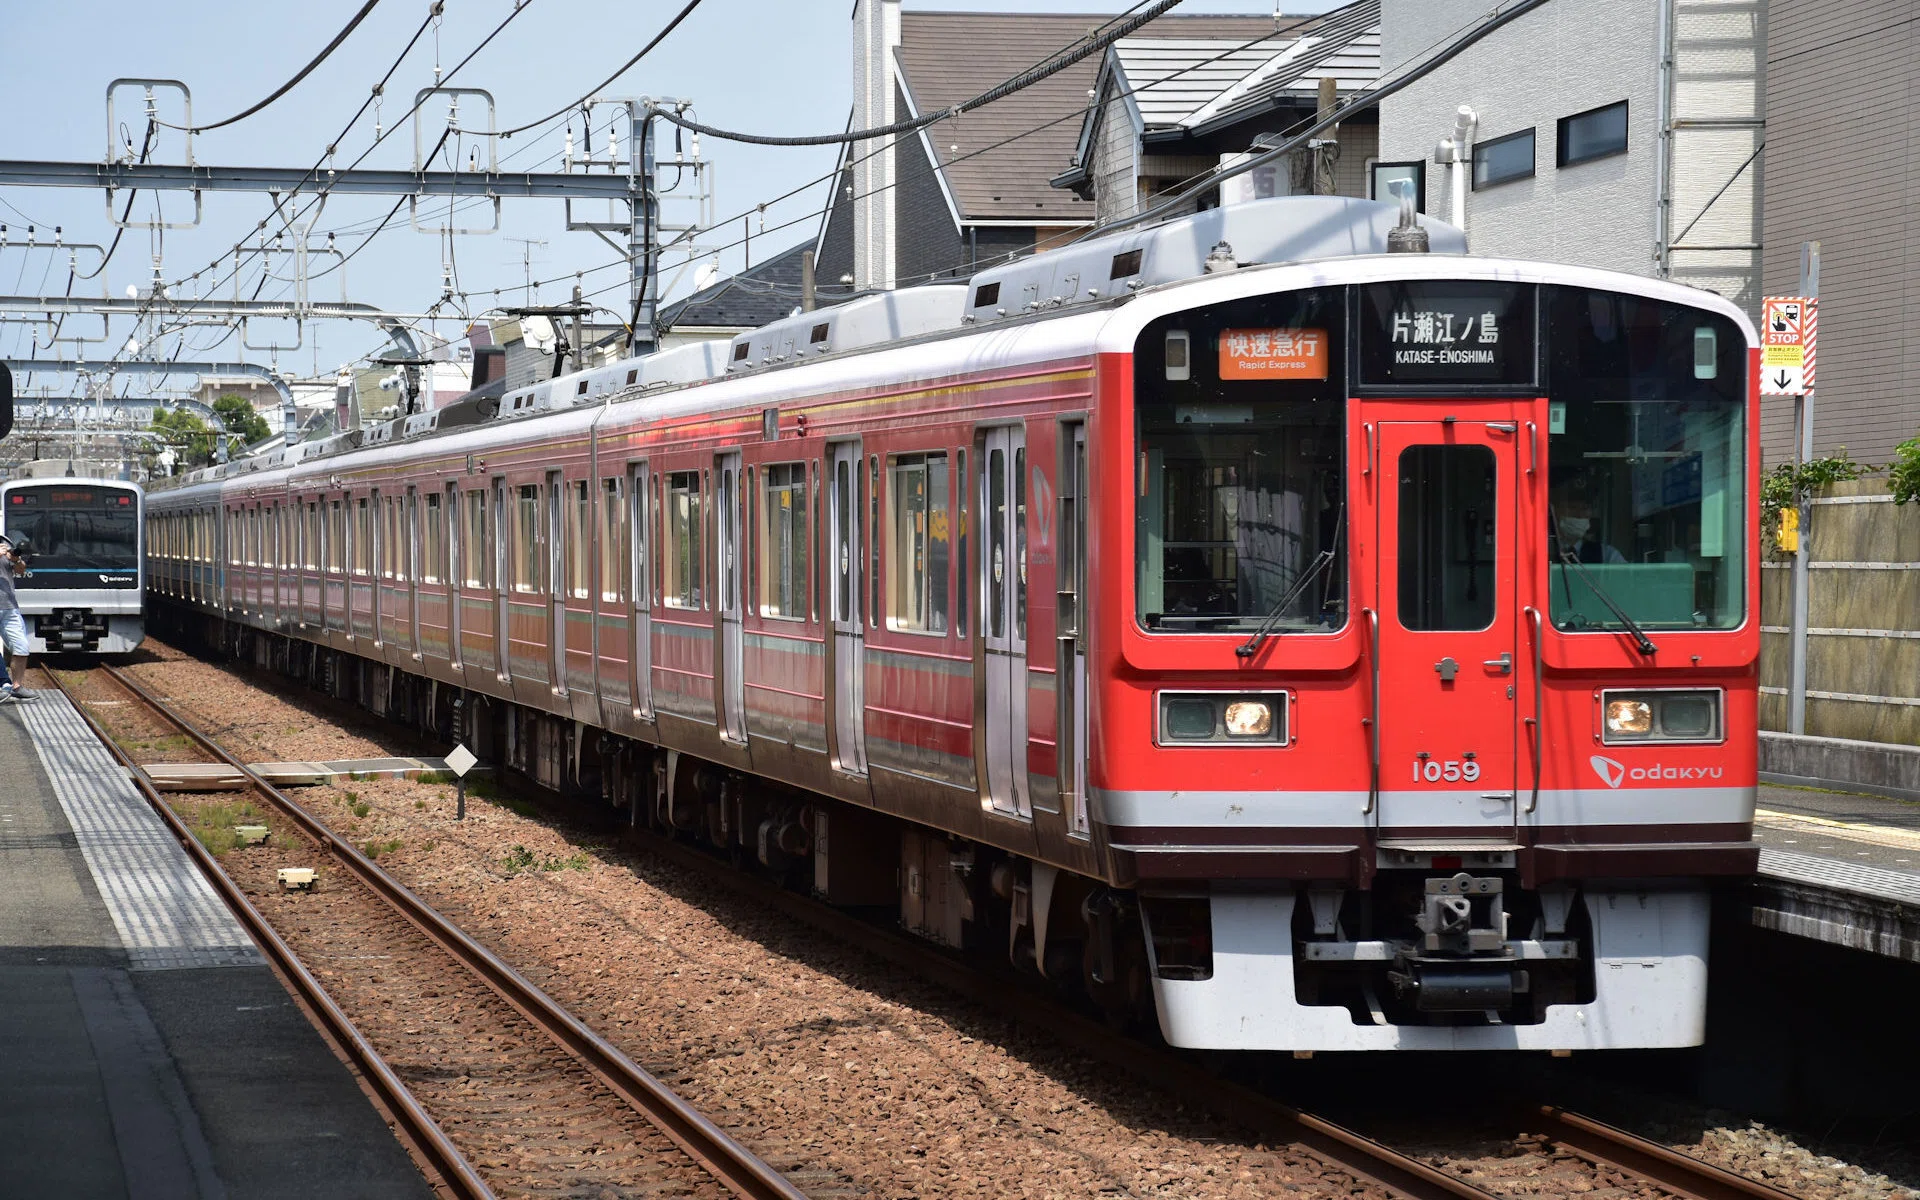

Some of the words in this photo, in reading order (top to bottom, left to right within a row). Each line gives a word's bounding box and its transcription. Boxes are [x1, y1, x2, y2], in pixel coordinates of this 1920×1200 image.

[1392, 311, 1499, 343] 片瀬江ノ島
[1227, 333, 1318, 357] 快速急行
[1769, 334, 1799, 343] STOP
[1395, 350, 1495, 363] KATASE-ENOSHIMA
[1239, 361, 1266, 370] Rapid
[1269, 361, 1306, 370] Express
[1413, 761, 1480, 782] 1059
[1630, 763, 1723, 780] odakyu
